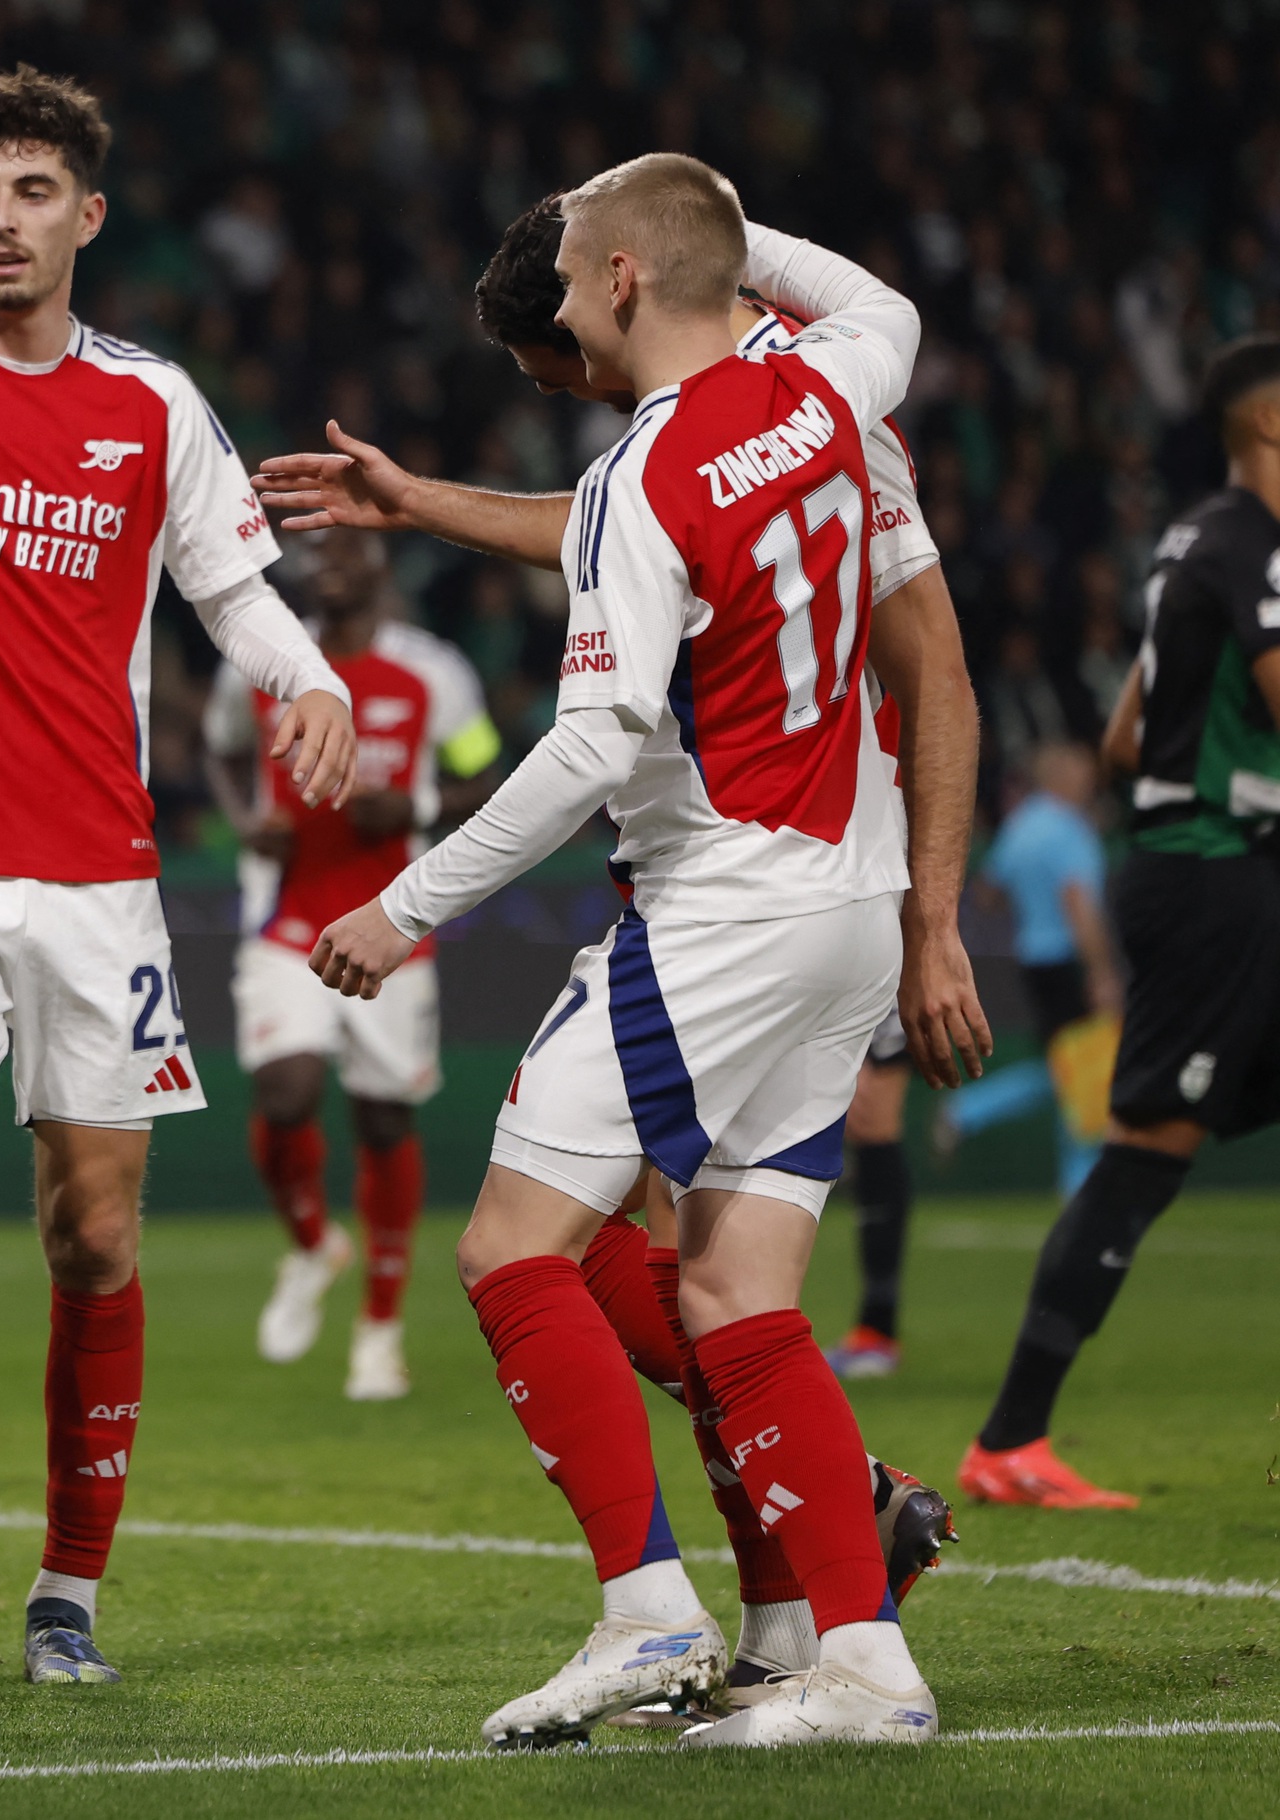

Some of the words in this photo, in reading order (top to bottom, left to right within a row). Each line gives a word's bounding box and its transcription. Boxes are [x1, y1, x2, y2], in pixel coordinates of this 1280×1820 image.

[870, 506, 912, 538] NDA
[14, 531, 100, 581] BETTER
[751, 470, 865, 735] 17
[564, 630, 607, 656] VISIT
[559, 652, 617, 682] WAND
[87, 1401, 141, 1421] AFC
[690, 1406, 725, 1432] FC
